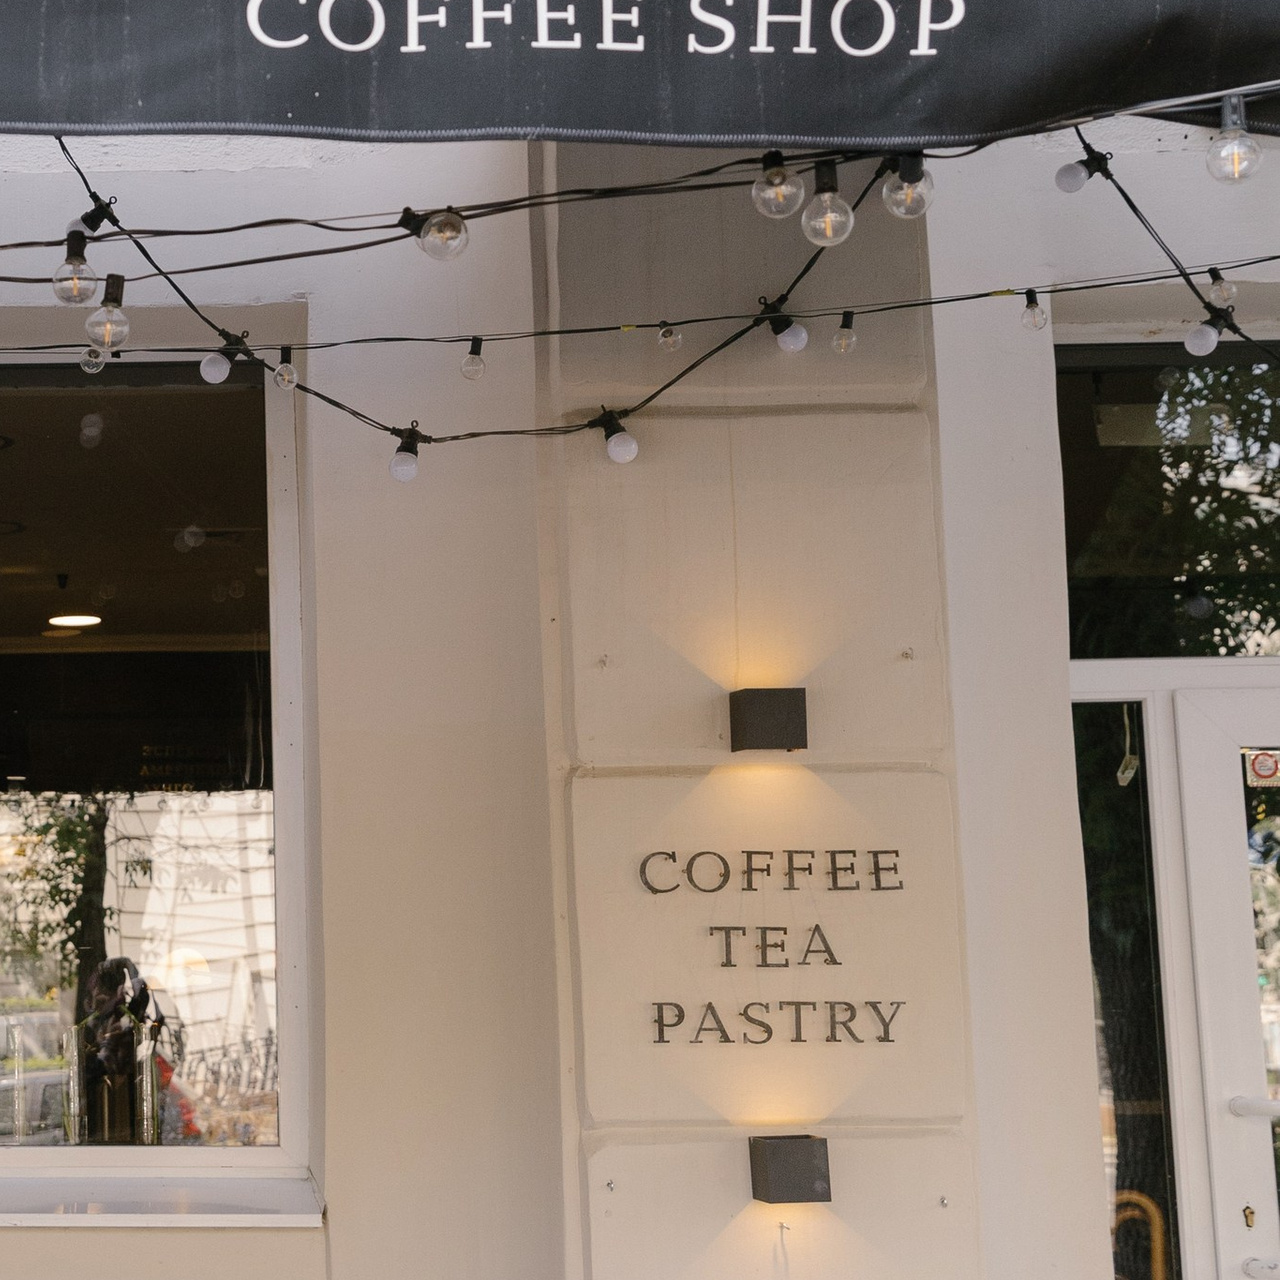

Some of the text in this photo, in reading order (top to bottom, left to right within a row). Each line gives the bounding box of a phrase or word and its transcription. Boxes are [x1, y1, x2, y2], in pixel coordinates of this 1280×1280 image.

[639, 850, 903, 894] COFFEE
[709, 924, 842, 967] TEA
[652, 1001, 906, 1044] PASTRY
